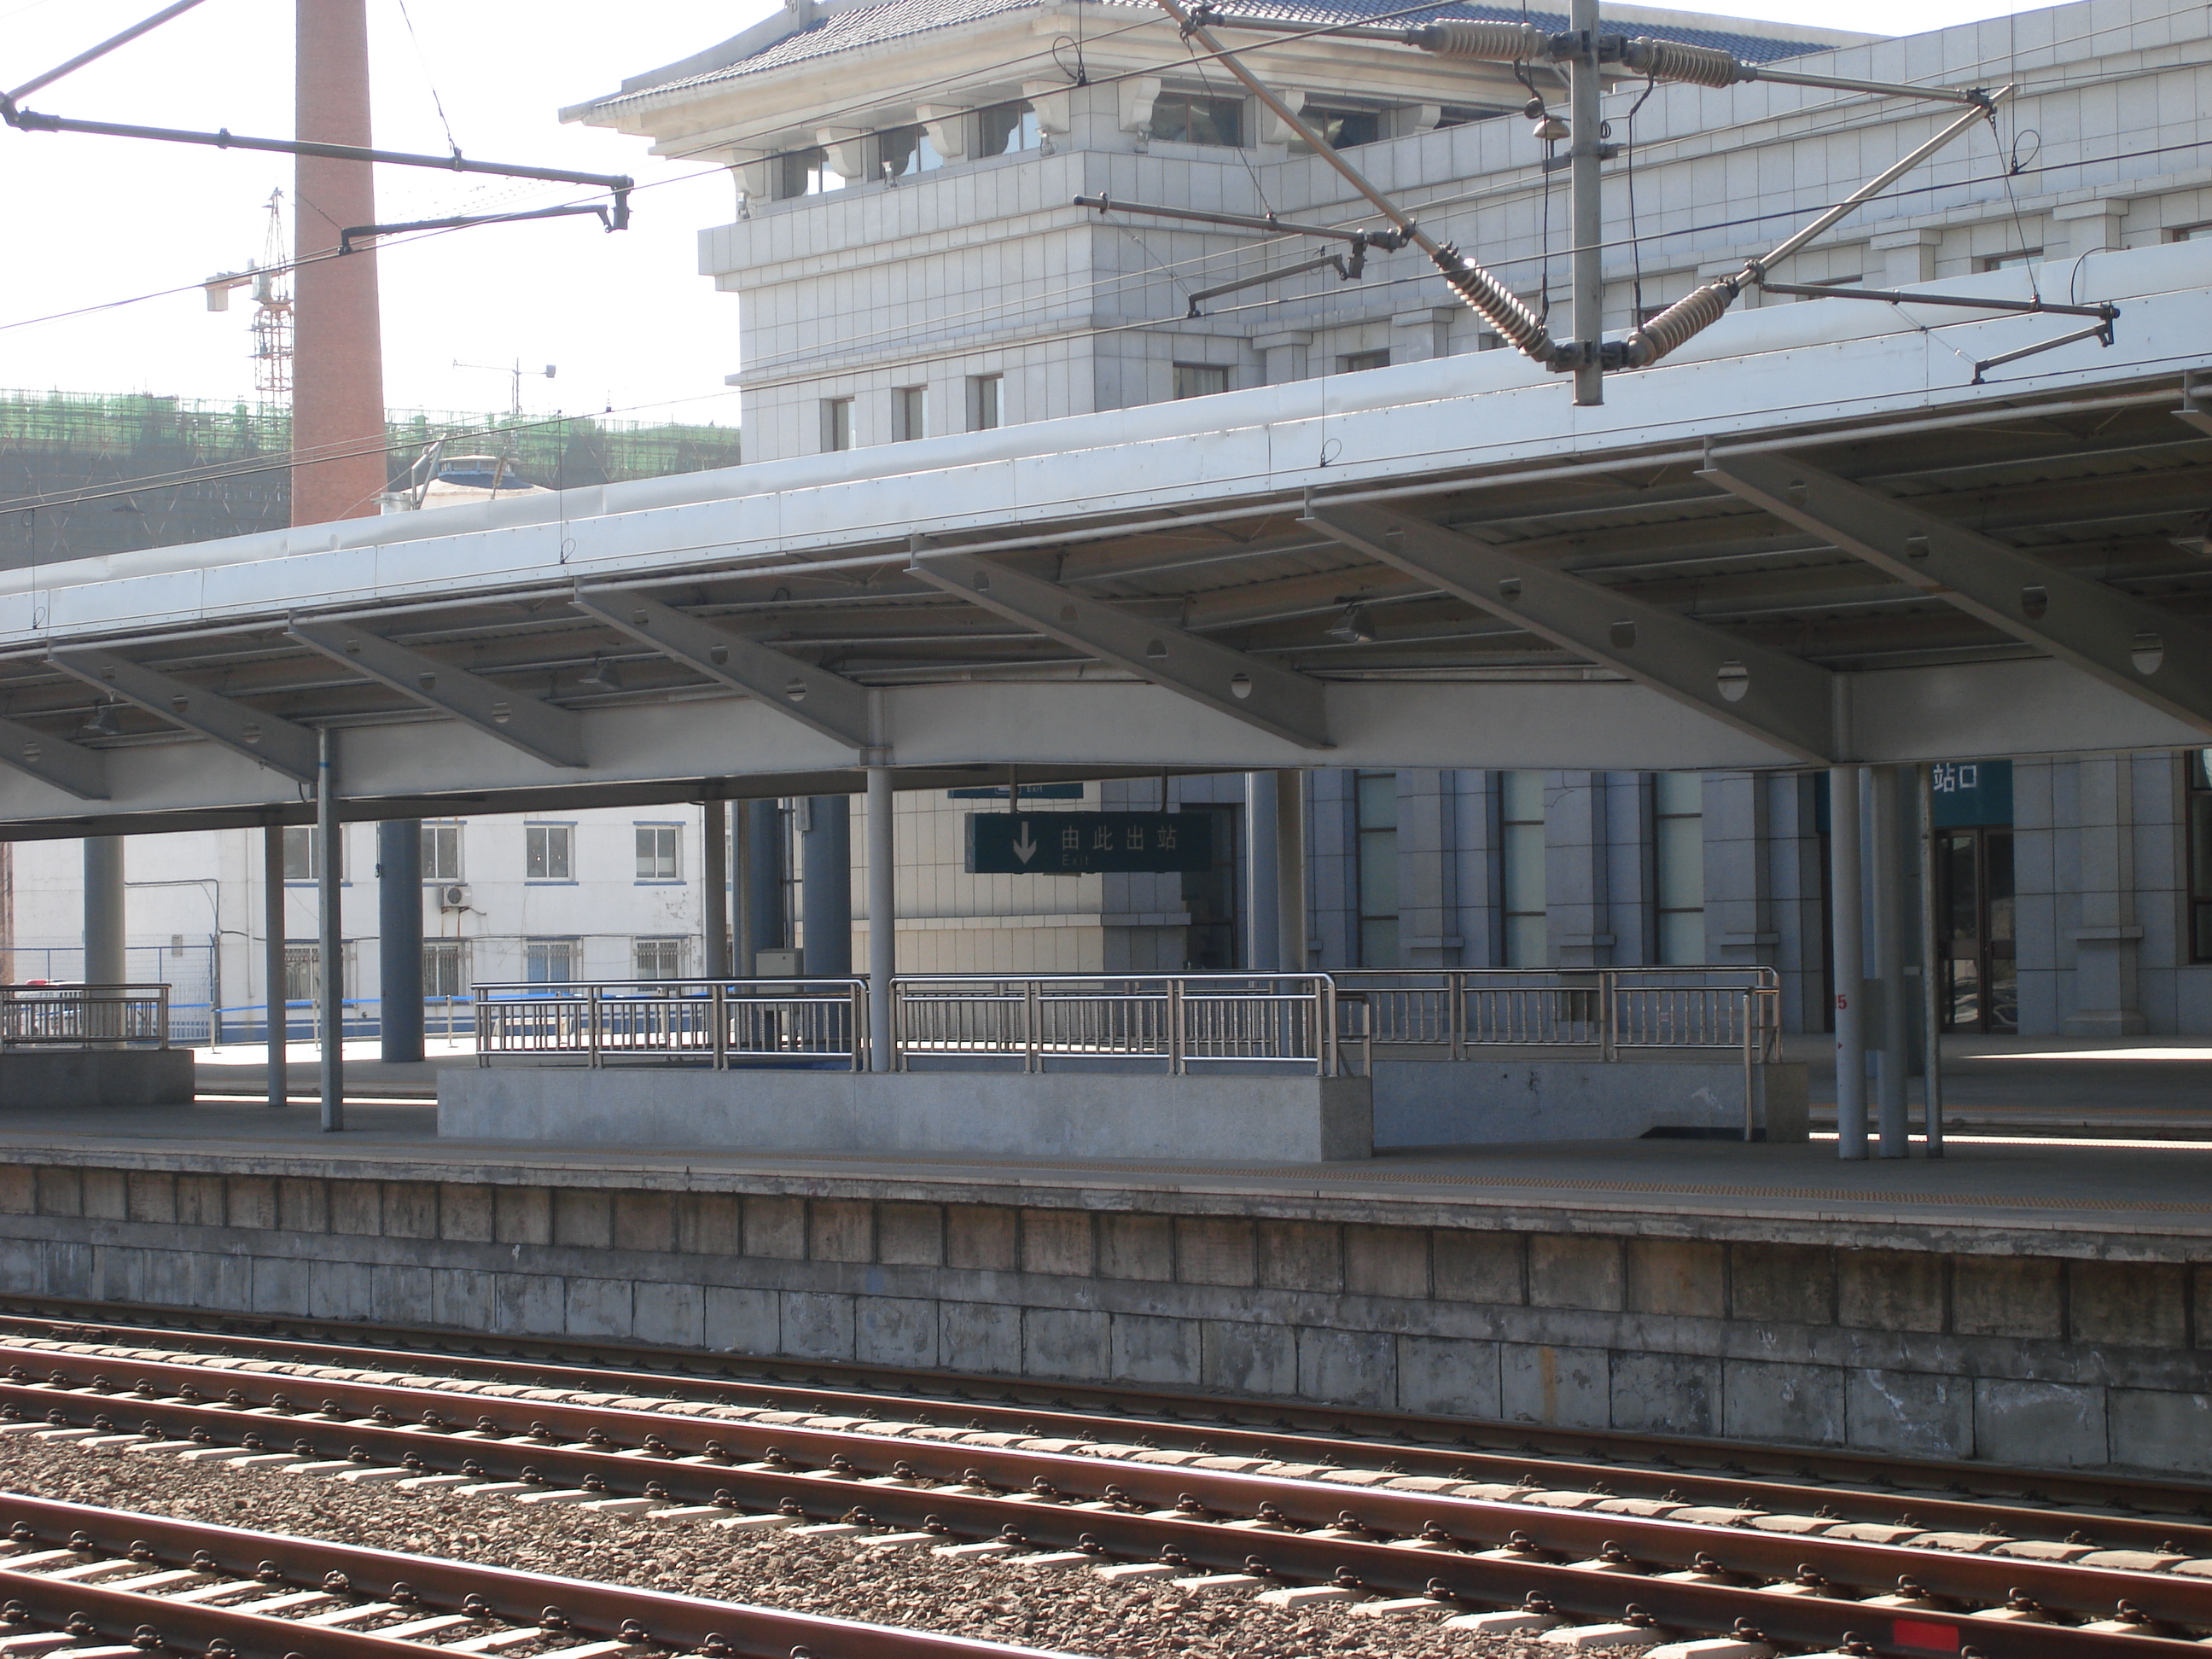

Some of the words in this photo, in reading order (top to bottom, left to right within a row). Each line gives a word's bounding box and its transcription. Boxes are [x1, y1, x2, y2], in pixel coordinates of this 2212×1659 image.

[1933, 762, 1977, 793] 站口
[1062, 824, 1177, 851] 由此出站
[1062, 854, 1089, 866] Exit
